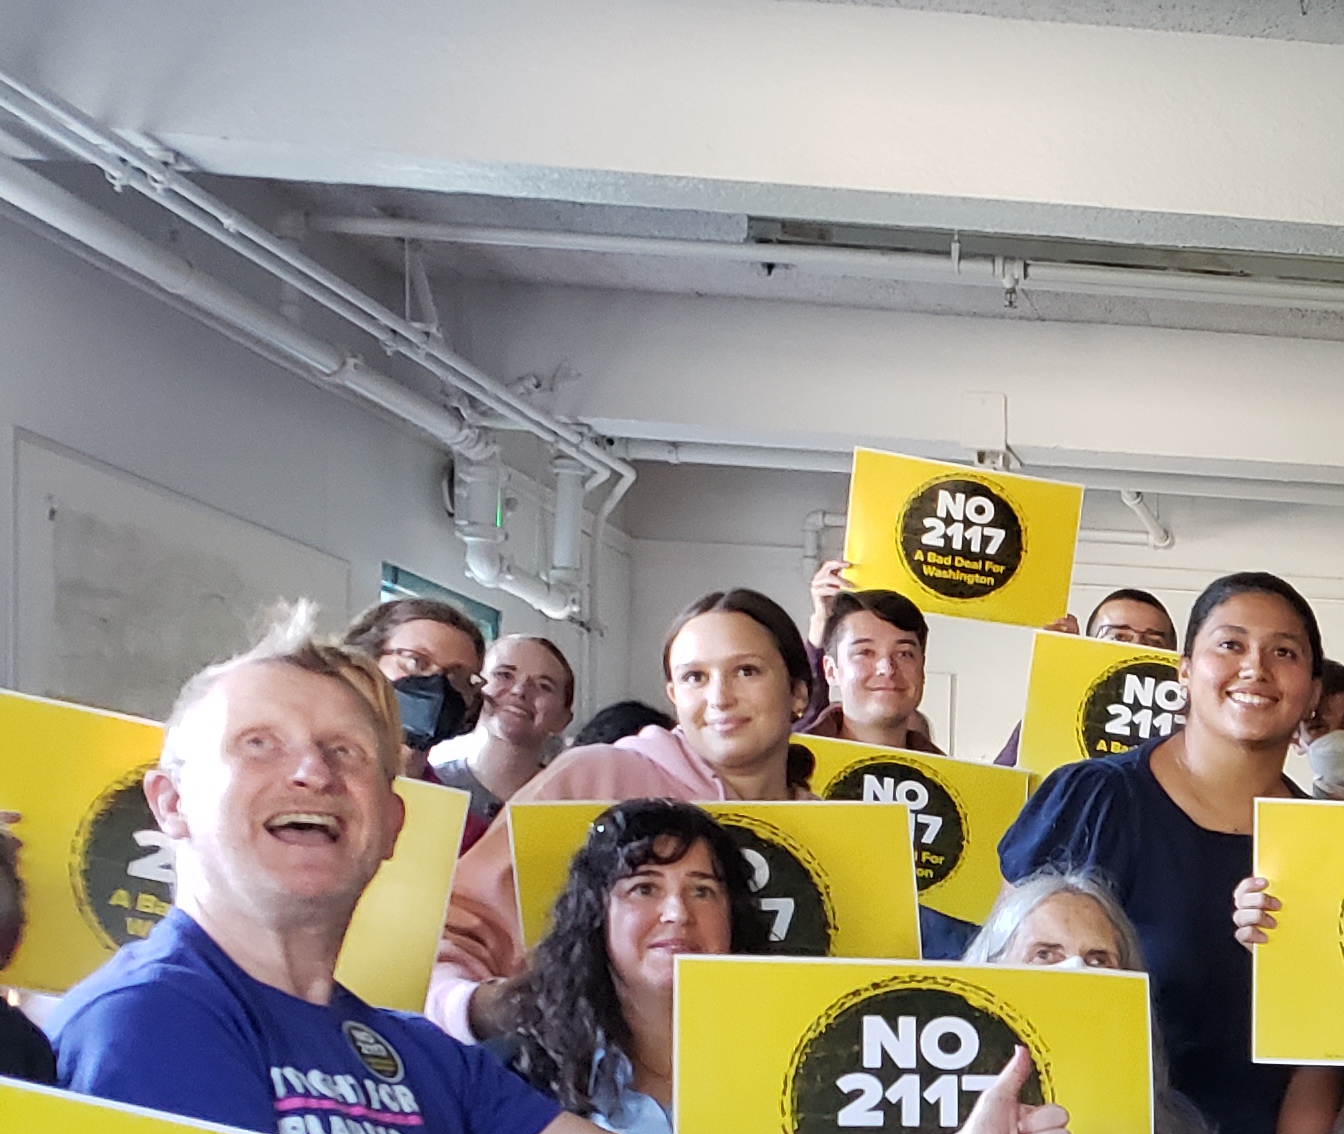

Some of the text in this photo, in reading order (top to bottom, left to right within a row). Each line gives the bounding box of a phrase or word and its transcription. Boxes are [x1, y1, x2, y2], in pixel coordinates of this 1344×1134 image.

[936, 489, 995, 524] NO
[921, 517, 1006, 555] 2117
[914, 549, 1006, 575] A Bad Deal For
[922, 563, 995, 587] Washington
[1123, 673, 1187, 711] NO
[1096, 739, 1108, 752] A
[863, 773, 929, 811] NO
[921, 850, 946, 867] For
[108, 889, 130, 909] A
[863, 1015, 980, 1070] NO
